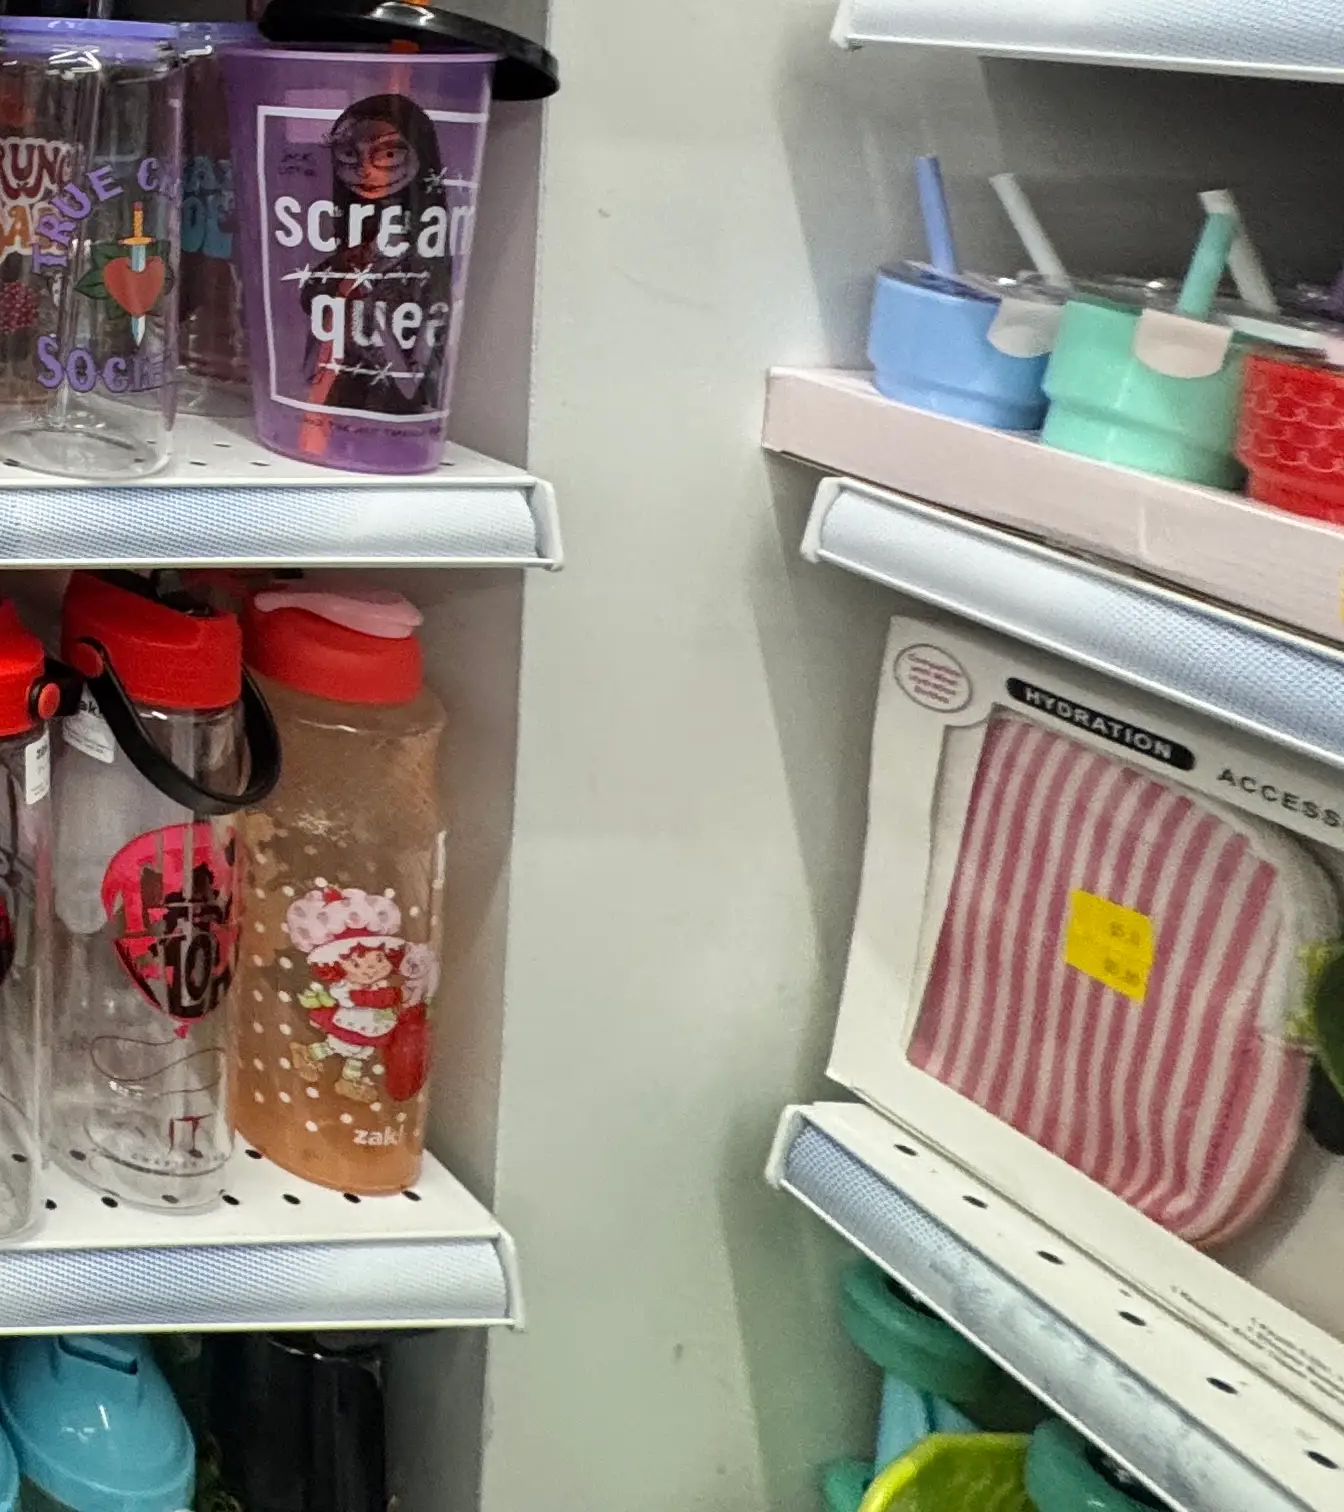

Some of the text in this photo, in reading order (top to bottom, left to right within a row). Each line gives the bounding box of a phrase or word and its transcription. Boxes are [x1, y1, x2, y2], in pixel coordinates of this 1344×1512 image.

[31, 164, 124, 275] TRUE
[1023, 687, 1344, 829] HYDRATION ACCESS
[352, 1124, 405, 1148] zak!
